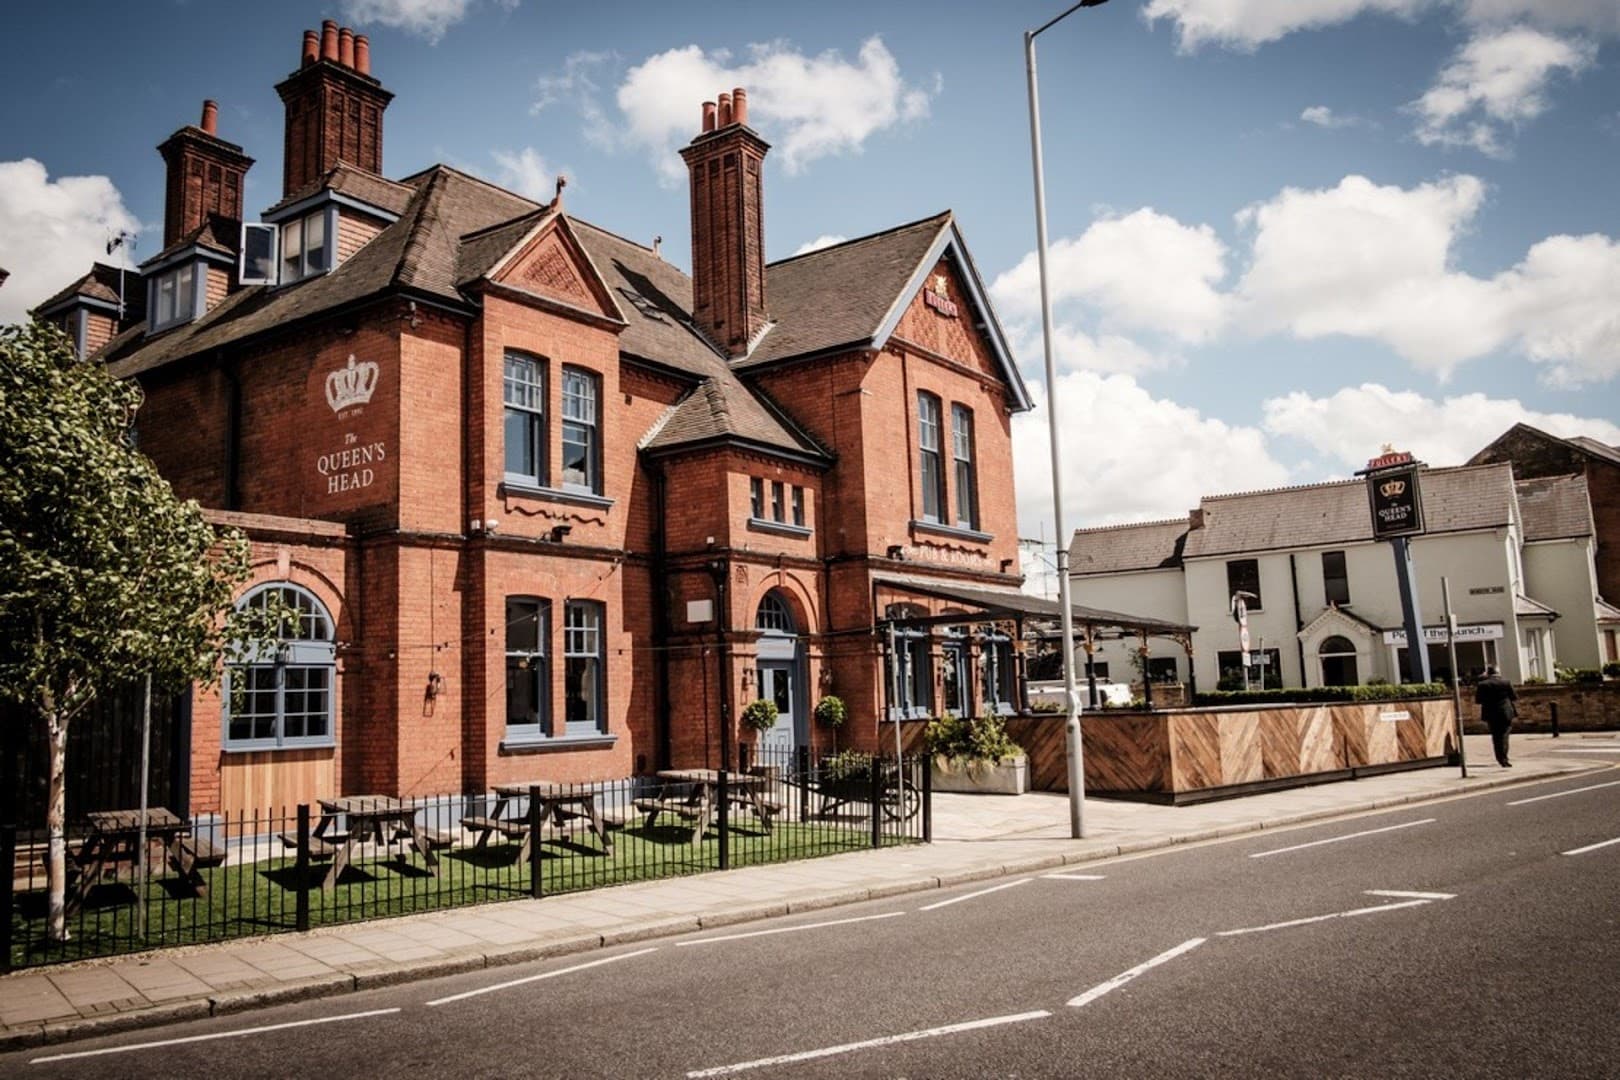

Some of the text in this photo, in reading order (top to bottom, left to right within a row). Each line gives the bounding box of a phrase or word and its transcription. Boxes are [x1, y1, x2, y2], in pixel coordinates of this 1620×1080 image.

[344, 432, 358, 444] The
[317, 442, 385, 475] QUEEN'S
[327, 469, 374, 494] HEAD
[1379, 505, 1411, 516] QUEEN'S
[1384, 511, 1407, 521] HEAD
[1429, 629, 1446, 637] the
